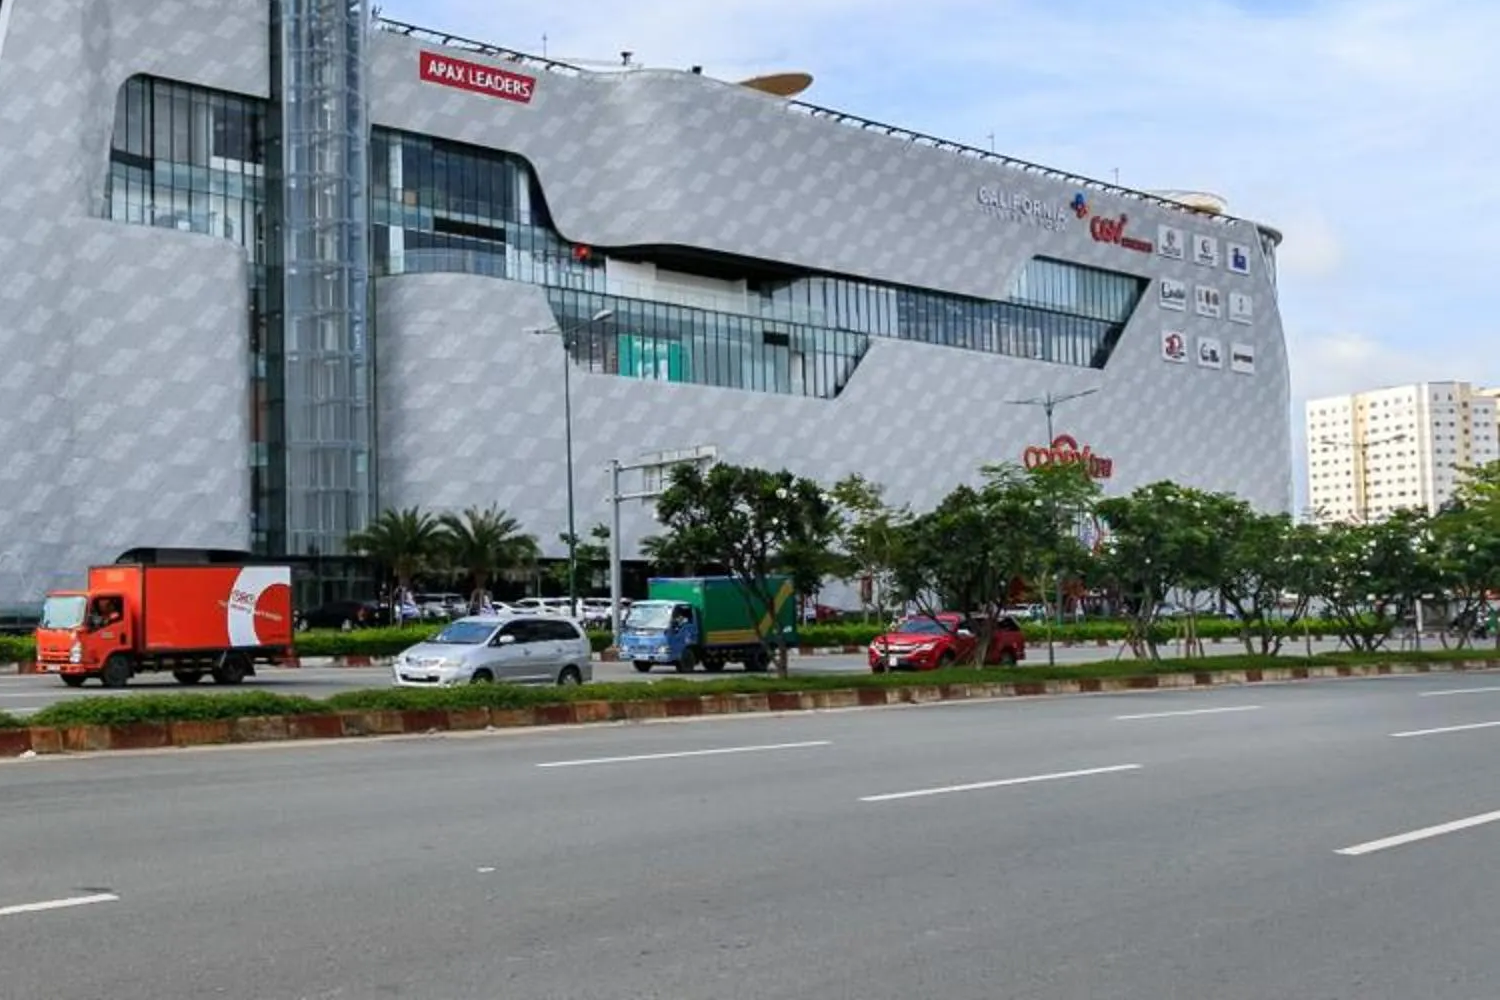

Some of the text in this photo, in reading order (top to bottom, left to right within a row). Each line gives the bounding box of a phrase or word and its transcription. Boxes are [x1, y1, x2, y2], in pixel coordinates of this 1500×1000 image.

[428, 59, 531, 98] APAX LEADERS
[977, 186, 1068, 224] CALIFORNIA
